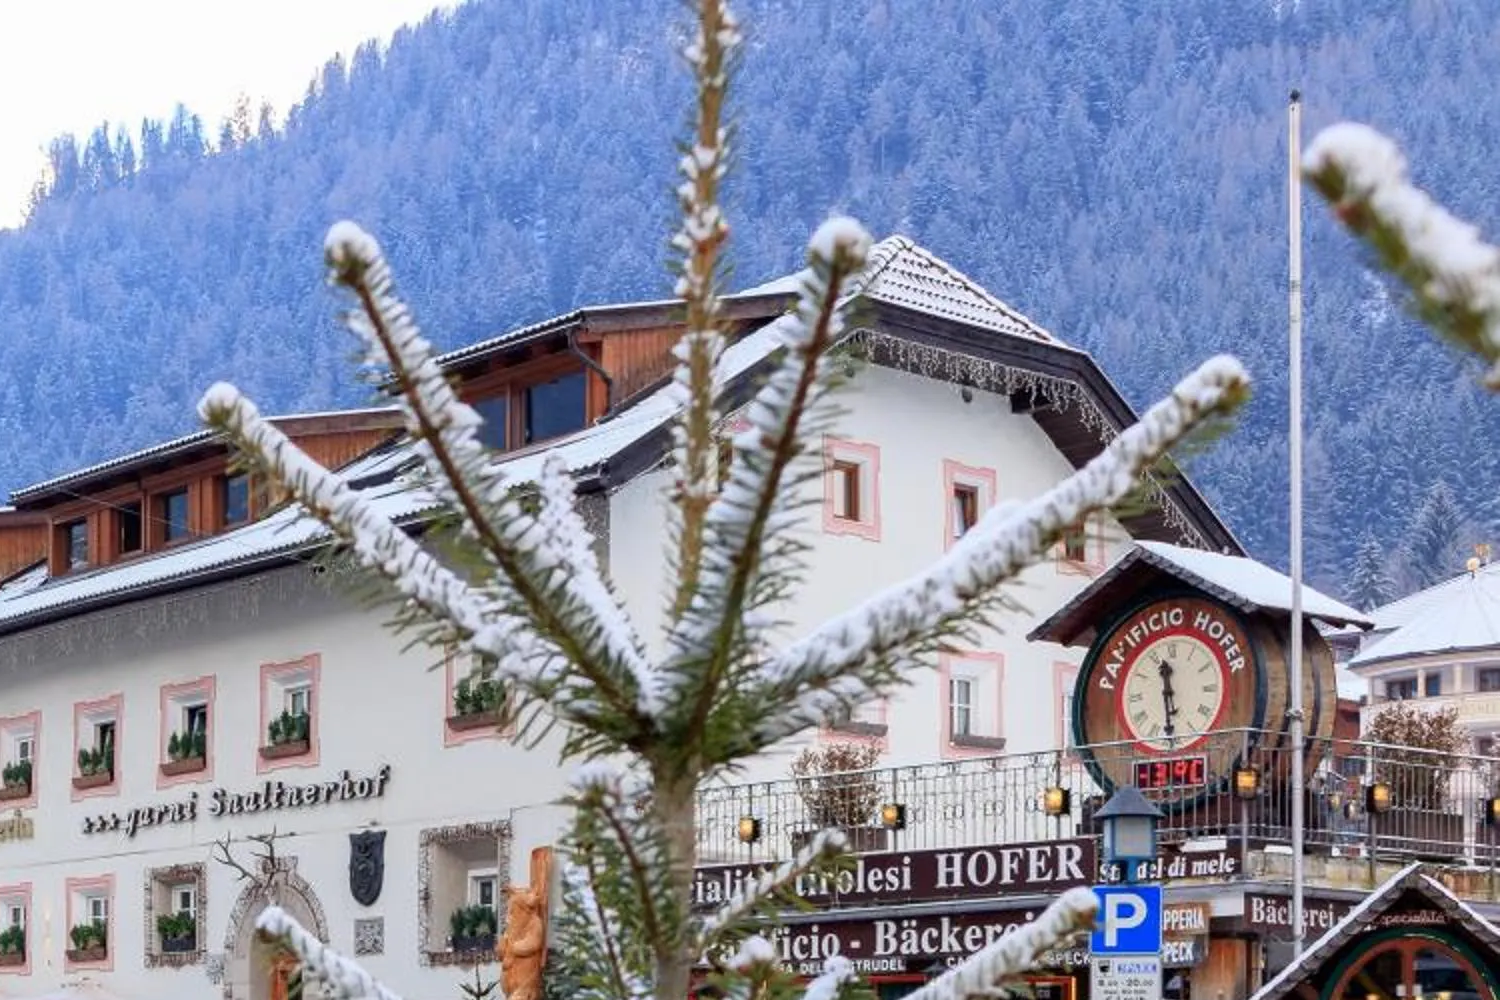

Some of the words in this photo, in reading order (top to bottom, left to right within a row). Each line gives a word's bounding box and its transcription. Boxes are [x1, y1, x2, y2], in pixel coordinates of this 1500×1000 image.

[1100, 608, 1184, 689] PANIFICIO
[1193, 612, 1245, 673] HOFER
[935, 844, 1085, 888] HOFER
[1168, 855, 1187, 877] di
[1192, 852, 1235, 876] mele
[1104, 893, 1148, 947] P
